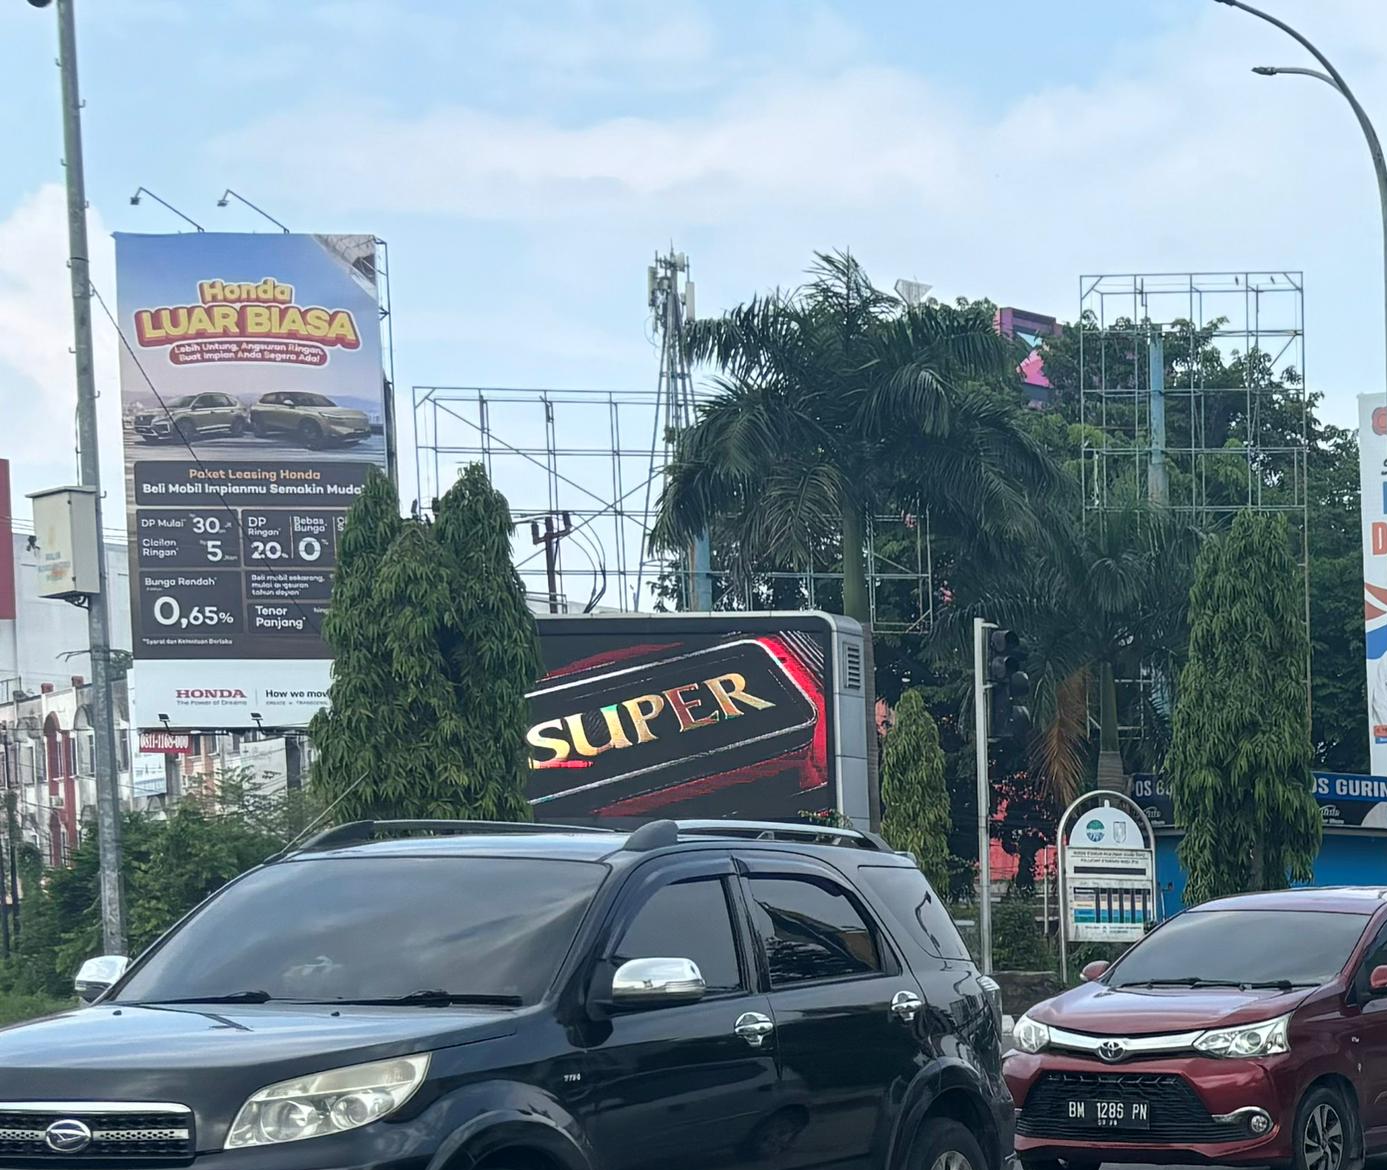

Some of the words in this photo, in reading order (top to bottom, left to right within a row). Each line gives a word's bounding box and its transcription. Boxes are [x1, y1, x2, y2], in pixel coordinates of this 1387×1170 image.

[201, 279, 291, 303] Honda
[138, 305, 241, 344] LUAR
[246, 304, 359, 344] BIASA
[189, 469, 226, 480] Paket
[229, 469, 277, 482] Leasing
[280, 469, 321, 480] Honda
[142, 483, 166, 494] Beli
[168, 483, 202, 494] Mobil
[205, 483, 267, 496] Impianmu
[269, 484, 324, 495] Semakin
[326, 484, 365, 495] Muda
[141, 519, 156, 528] DP
[192, 517, 221, 534] 30
[247, 516, 267, 528] DP
[293, 515, 325, 525] Bebas
[142, 538, 177, 548] Cicilan
[206, 540, 224, 562] 5
[144, 577, 176, 588] Bunga
[154, 595, 234, 629] 0,65%
[255, 605, 288, 616] Tenor
[175, 688, 247, 699] HONDA
[265, 689, 289, 699] How
[290, 691, 305, 699] we
[525, 672, 778, 763] SUPER
[1068, 1101, 1086, 1118] BM
[1132, 1103, 1148, 1120] PN
